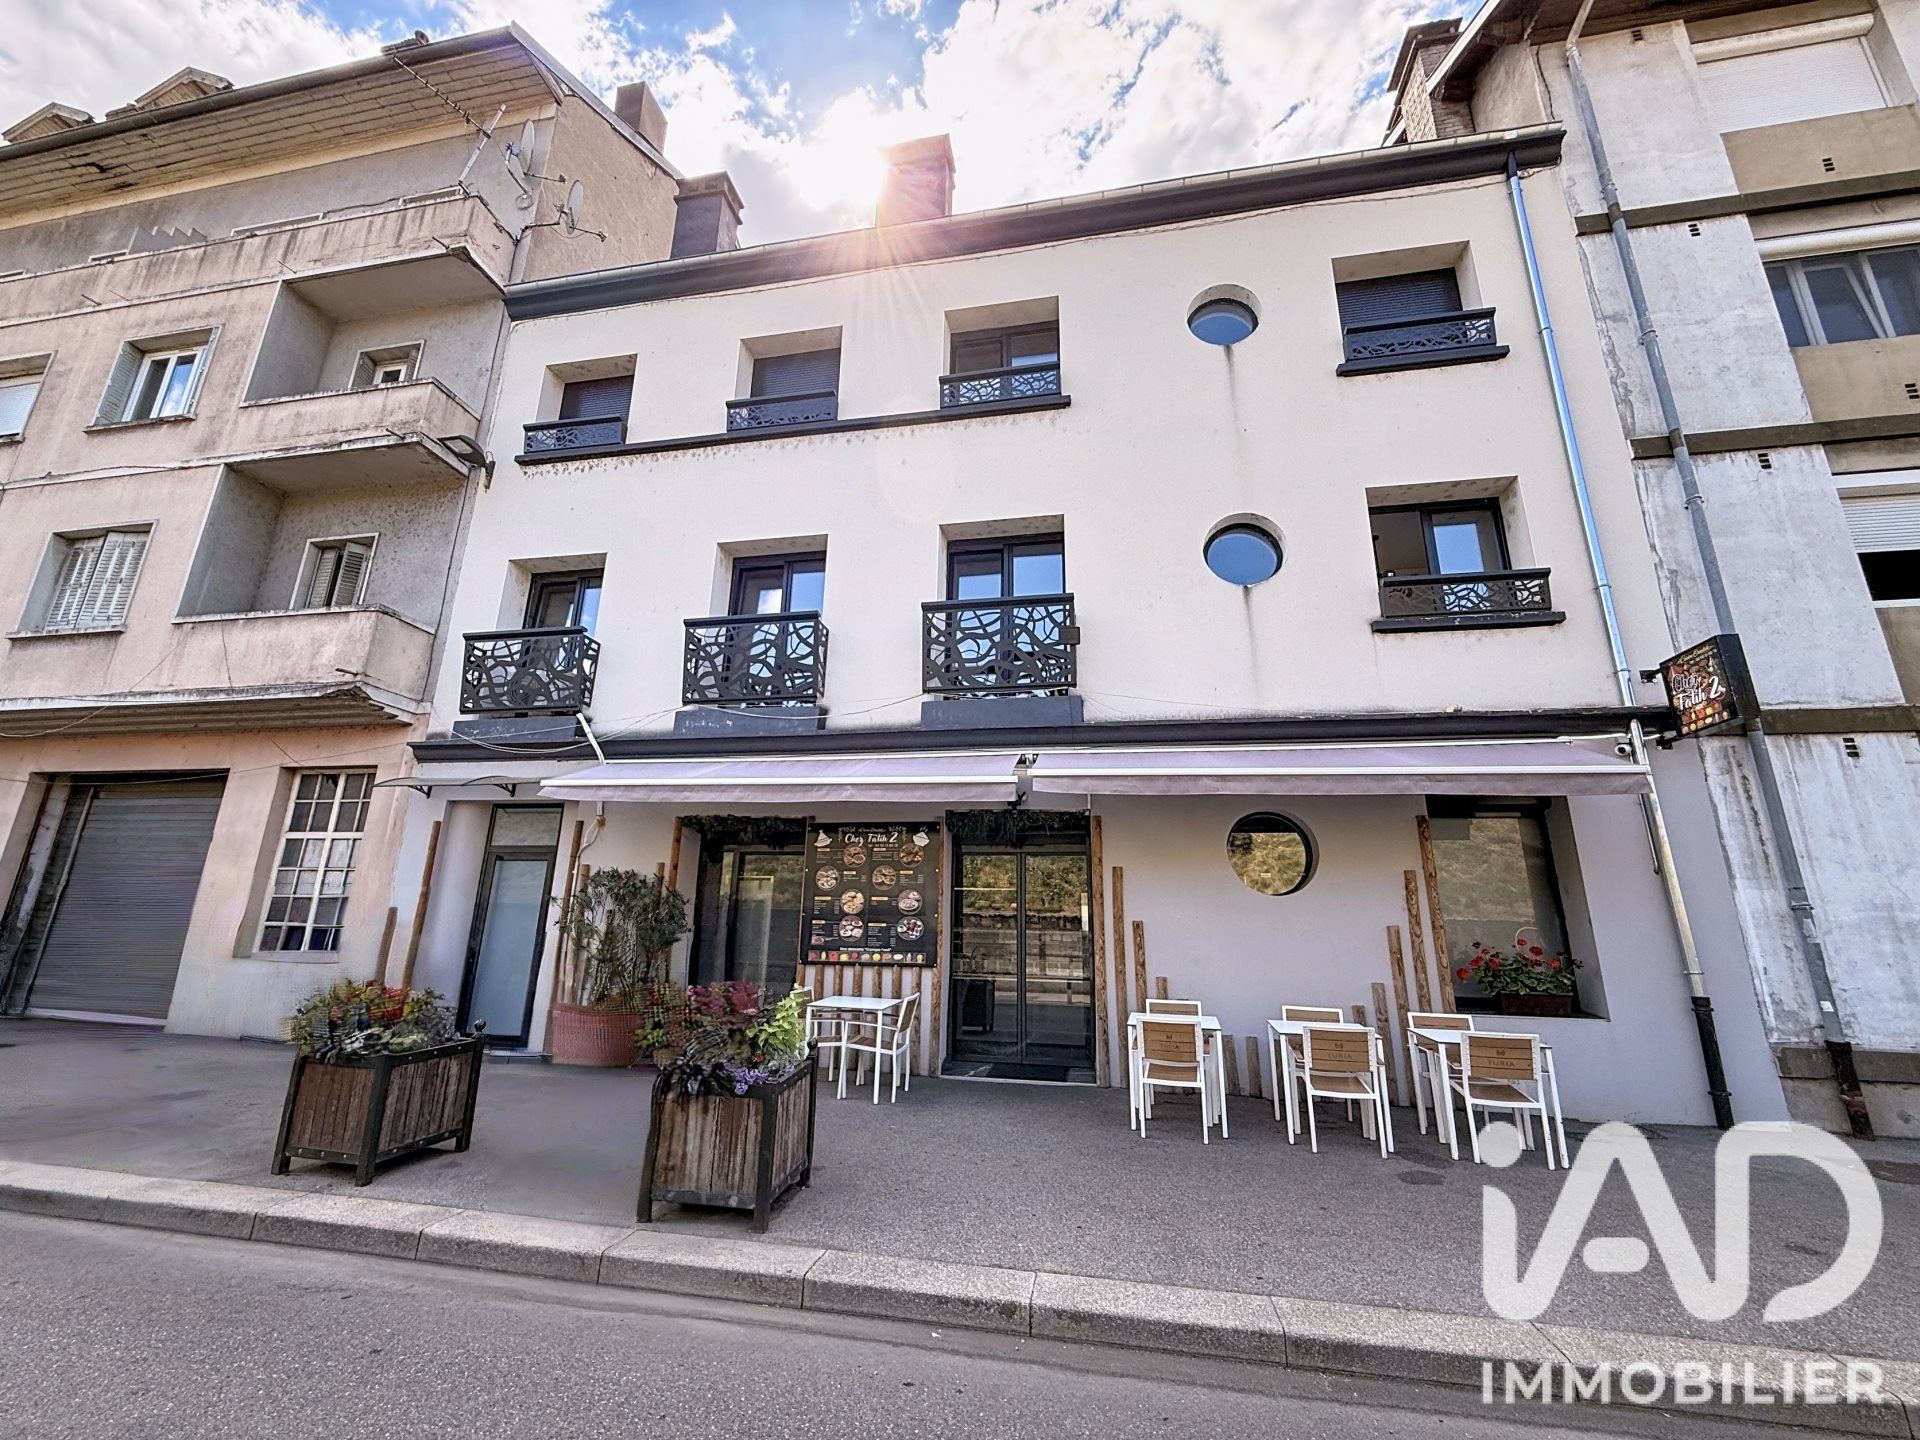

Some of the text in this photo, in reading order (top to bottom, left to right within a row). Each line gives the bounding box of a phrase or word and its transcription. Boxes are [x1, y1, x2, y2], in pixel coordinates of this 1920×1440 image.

[1672, 674, 1701, 692] Chez
[1675, 676, 1721, 710] Fatih 2
[845, 832, 864, 846] Chez
[889, 831, 898, 843] 2
[1487, 1059, 1515, 1067] TURIA
